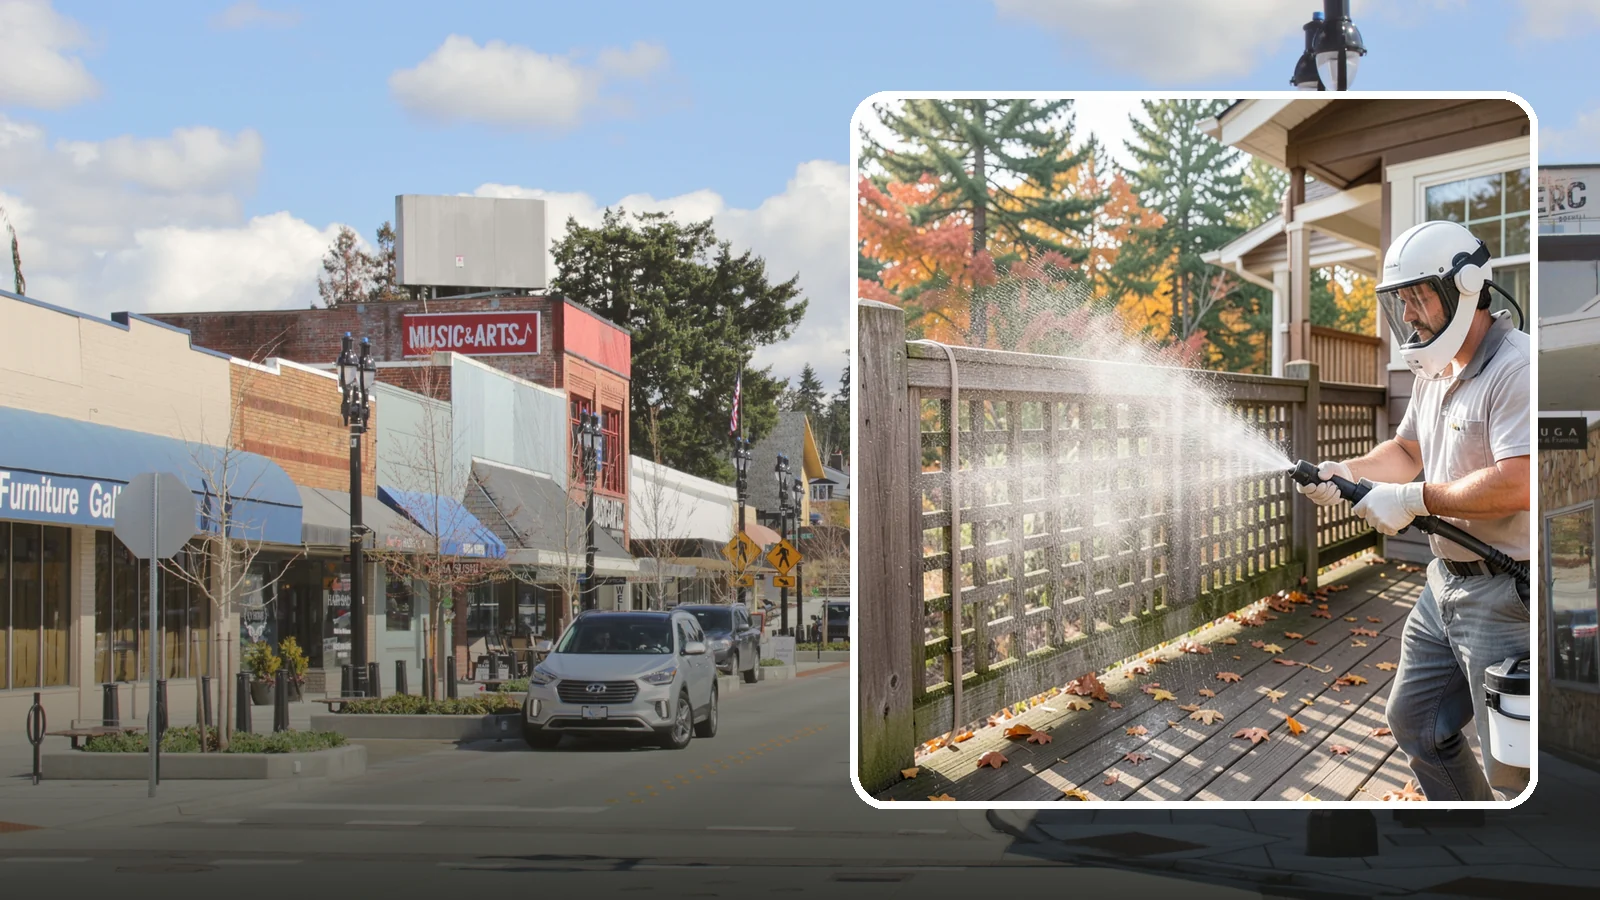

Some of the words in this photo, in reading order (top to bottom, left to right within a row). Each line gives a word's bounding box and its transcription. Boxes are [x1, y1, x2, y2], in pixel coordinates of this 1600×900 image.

[1541, 428, 1577, 436] UGA
[1552, 436, 1579, 444] Framing
[0, 471, 79, 515] Furniture
[453, 563, 479, 574] SUSHI
